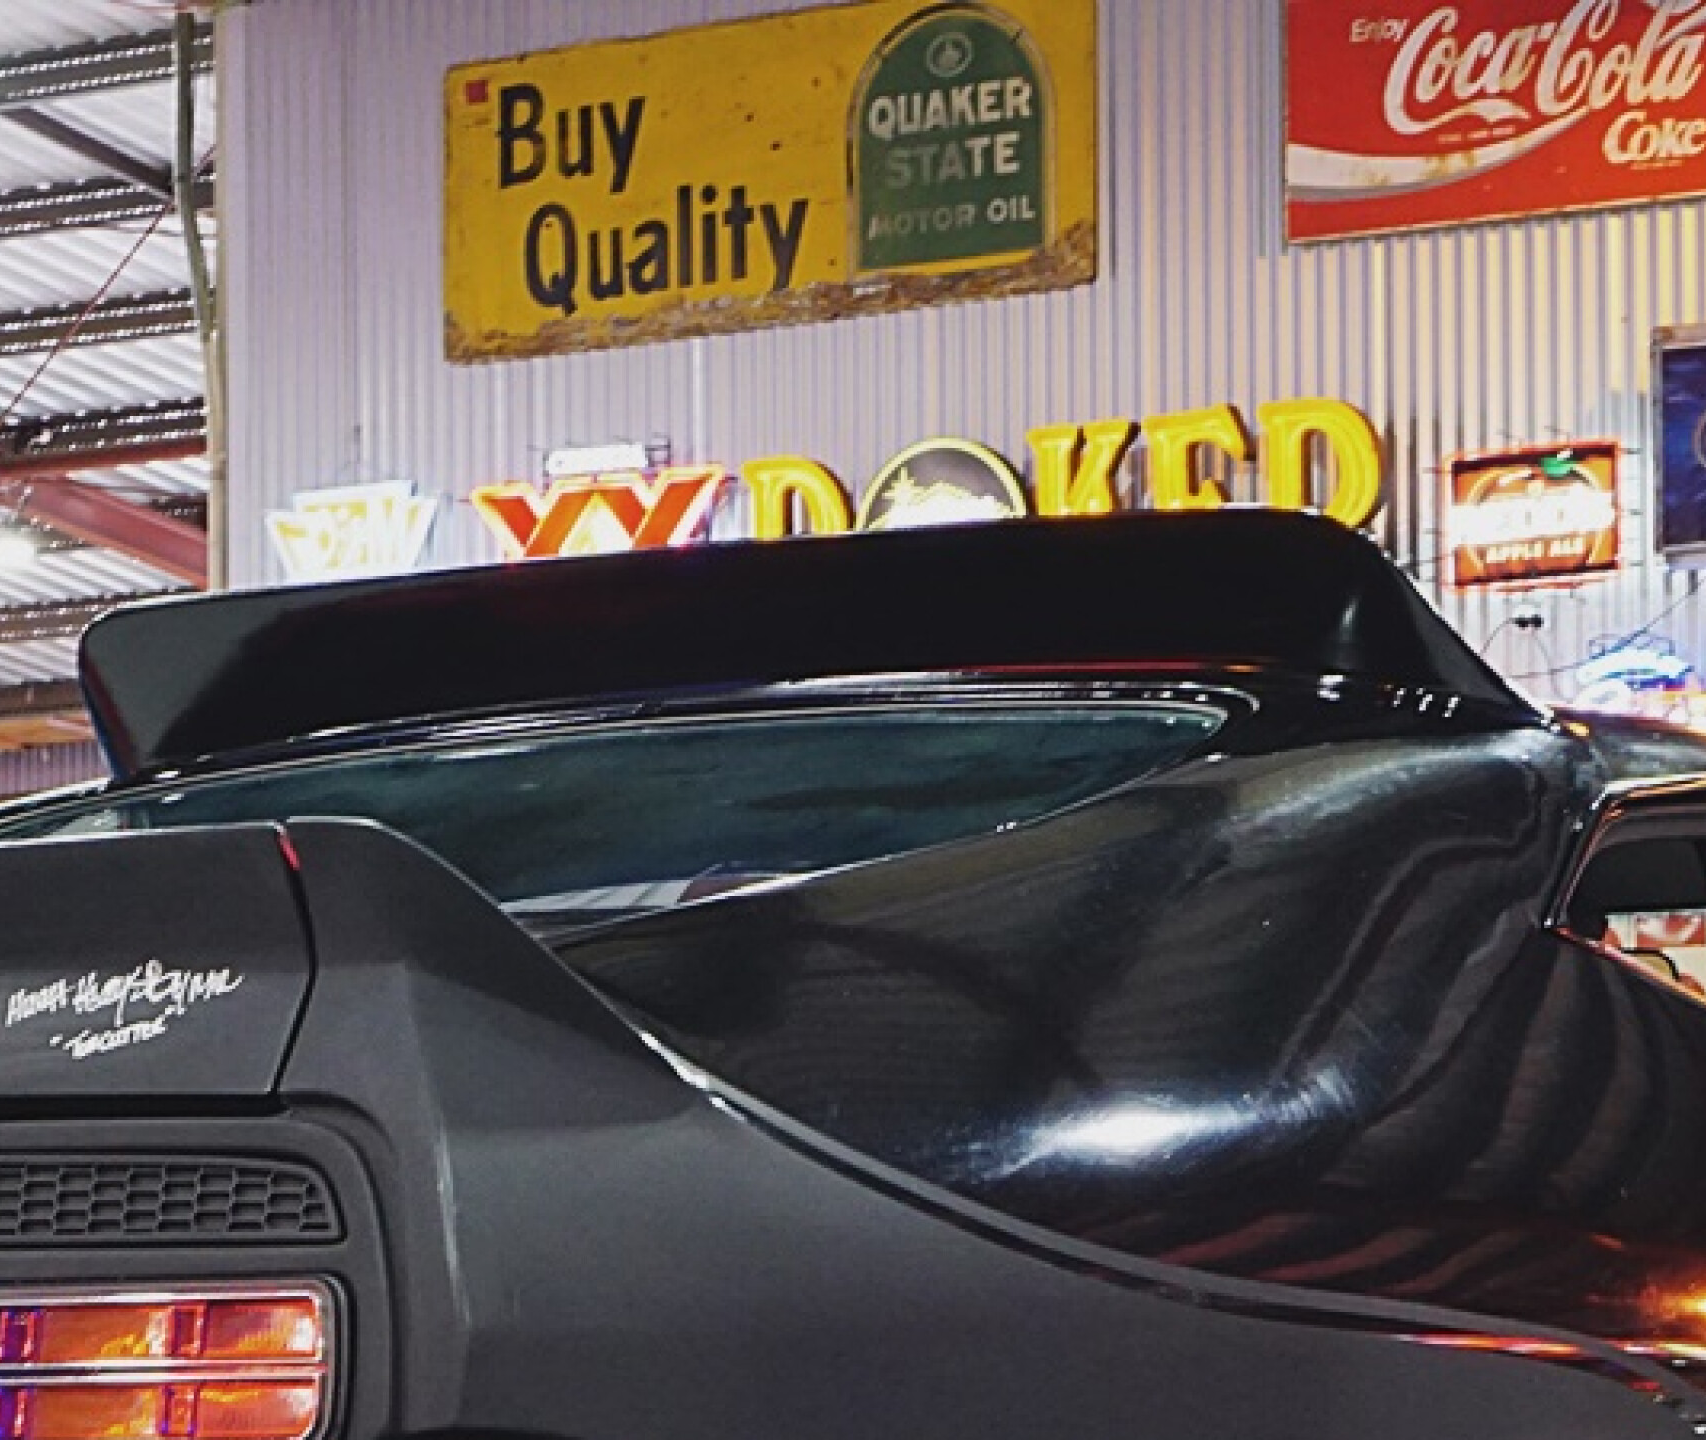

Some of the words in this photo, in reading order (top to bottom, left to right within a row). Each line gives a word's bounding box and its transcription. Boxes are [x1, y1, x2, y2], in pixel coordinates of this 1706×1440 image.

[1349, 18, 1409, 43] Enjoy
[1383, 0, 1706, 135] Coca-Cola
[497, 82, 645, 194] Buy
[868, 77, 1033, 140] QUAKER
[885, 131, 1021, 189] STATE
[867, 203, 976, 241] MOTOR
[986, 195, 1036, 225] OIL
[525, 183, 809, 317] Quality
